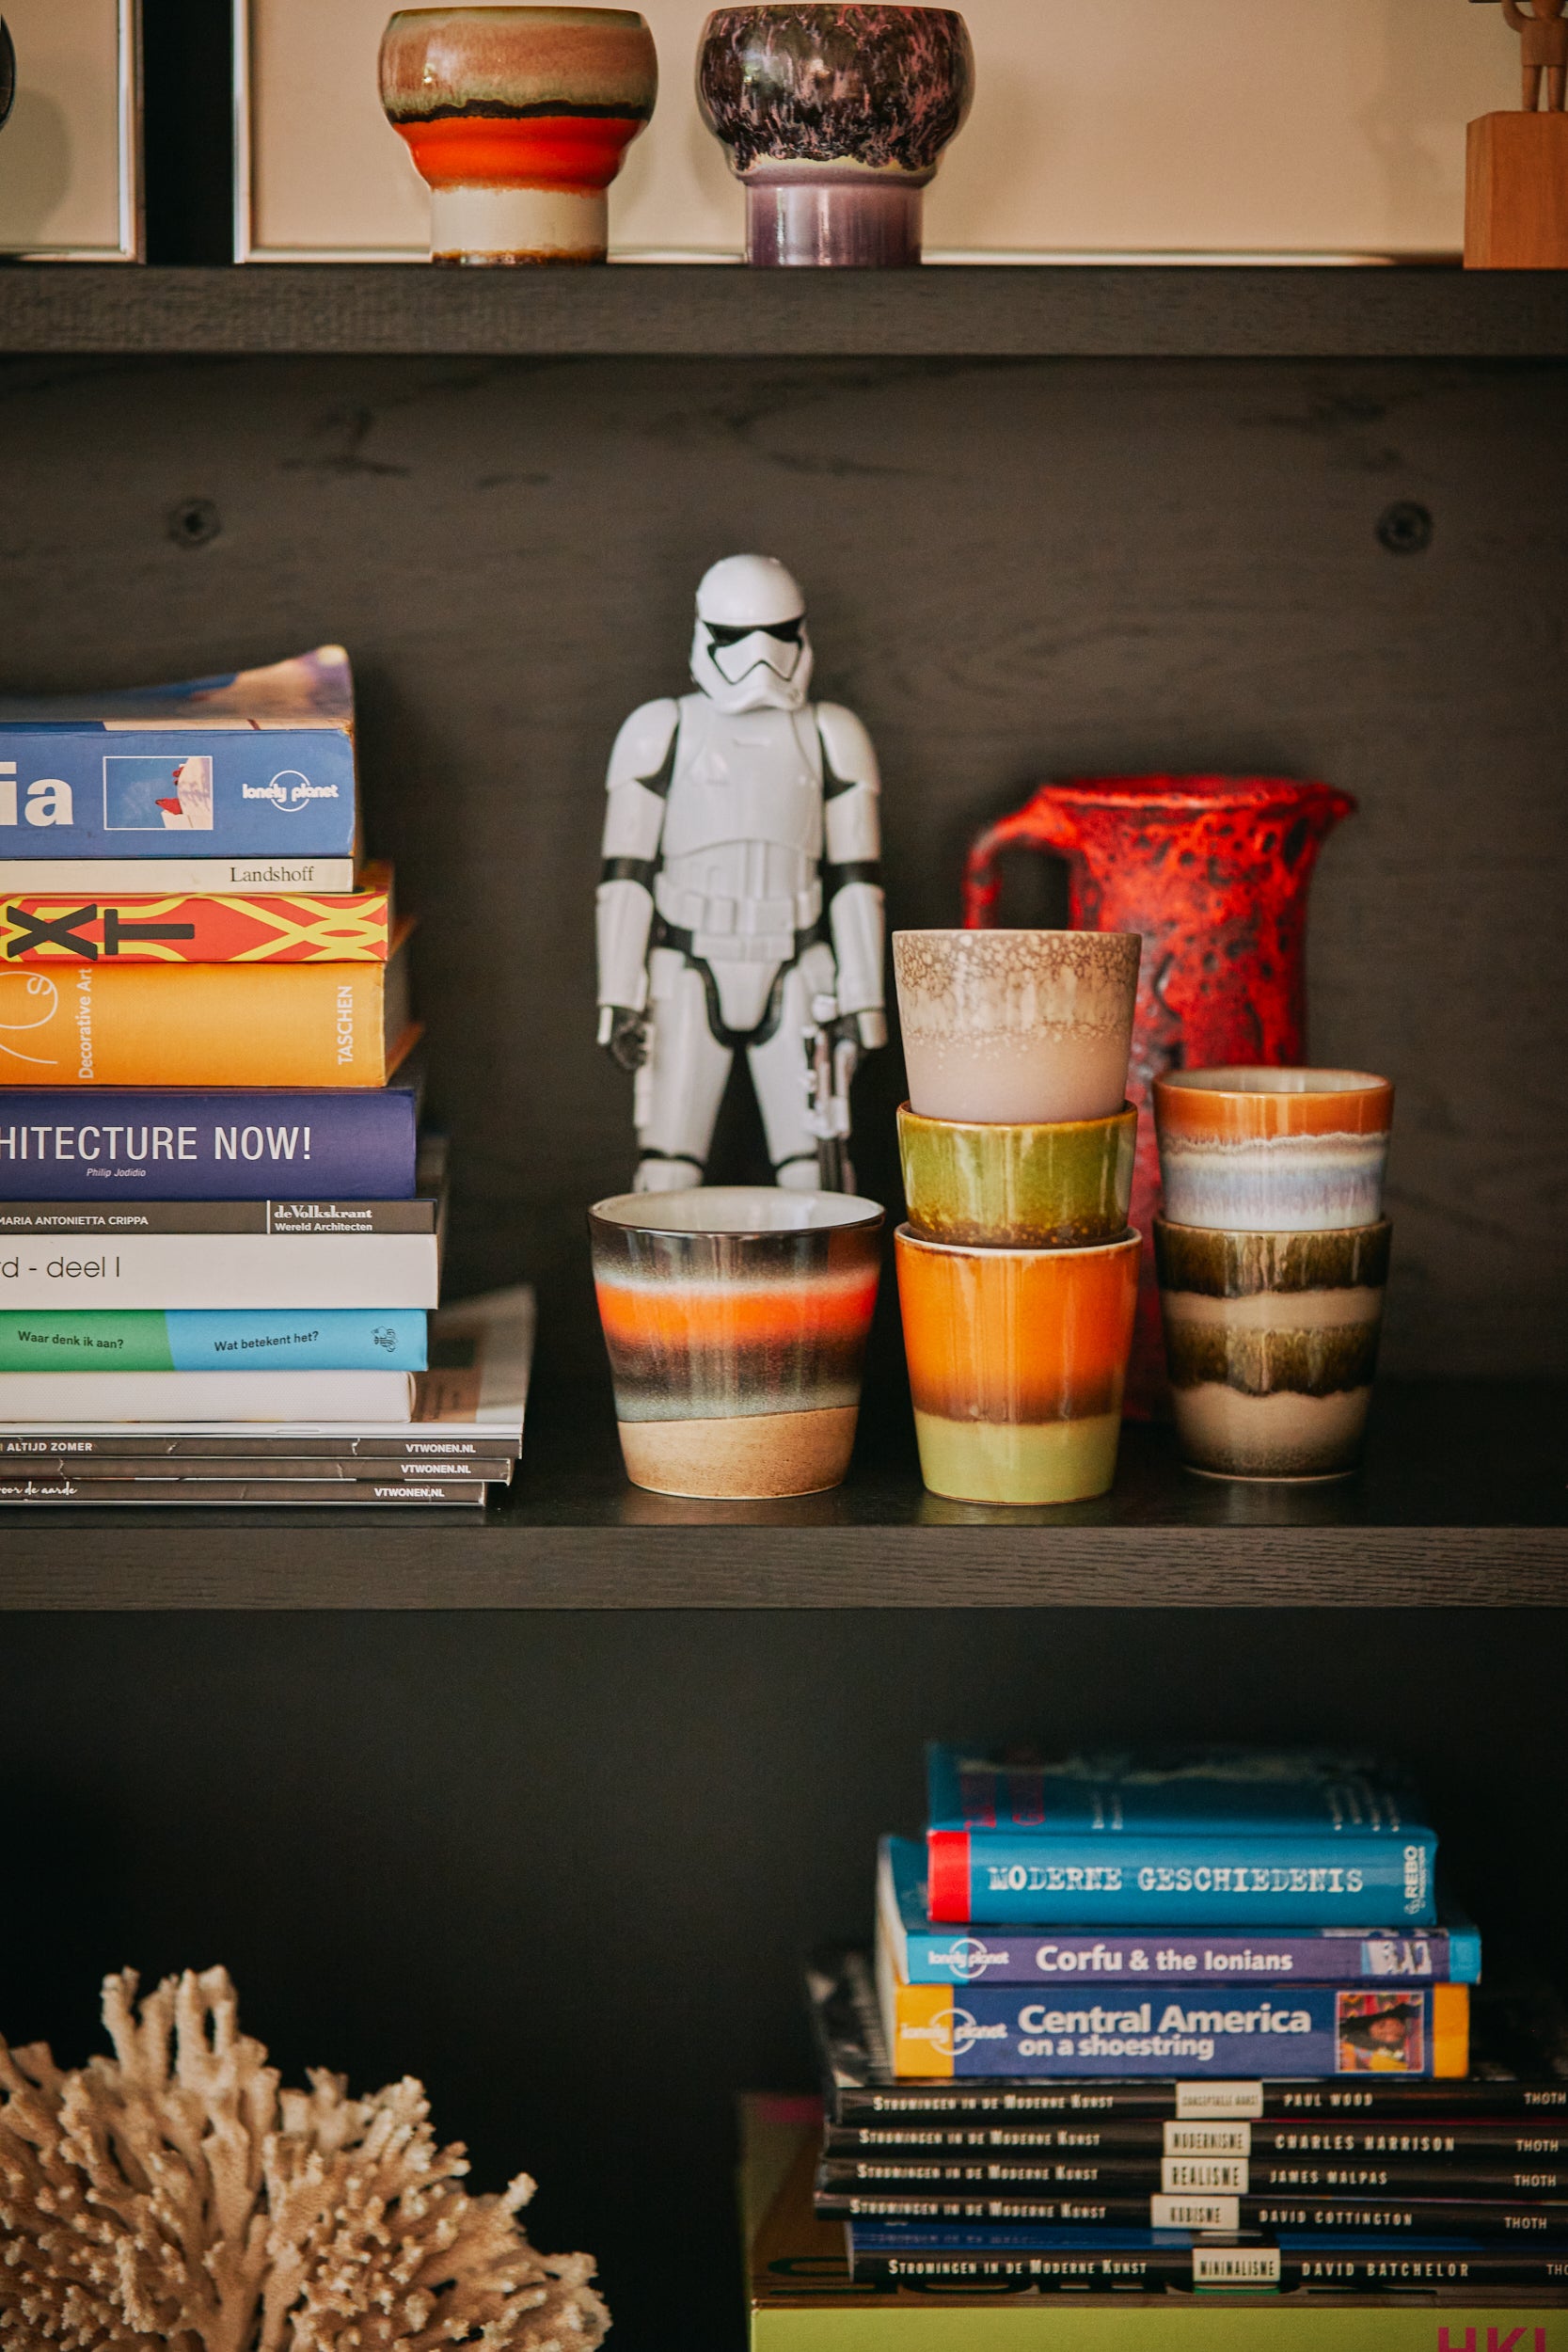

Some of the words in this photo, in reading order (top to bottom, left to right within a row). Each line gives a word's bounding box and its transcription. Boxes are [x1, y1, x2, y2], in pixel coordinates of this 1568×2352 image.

[242, 783, 287, 802] lonely
[291, 783, 340, 802] planet
[230, 866, 314, 882] Landshoff
[76, 967, 92, 992] Art
[336, 986, 354, 1065] TASCHEN
[76, 995, 94, 1079] Decorative
[214, 1126, 310, 1161] NOW!
[86, 1168, 112, 1179] Philip
[113, 1168, 147, 1177] Jodidio
[34, 1216, 106, 1226] ANTONIETTA
[107, 1216, 150, 1225] CRIPPA
[274, 1222, 312, 1232] Wereld
[313, 1222, 373, 1232] Architecten
[0, 1256, 19, 1279] d
[46, 1256, 105, 1279] deel
[17, 1330, 50, 1343] Waar
[52, 1333, 81, 1346] denk
[83, 1336, 94, 1347] ik
[96, 1339, 124, 1349] aan?
[214, 1341, 239, 1352] Wat
[241, 1335, 292, 1349] betekent
[293, 1330, 319, 1343] het?
[6, 1442, 48, 1452] ALTIJD
[50, 1442, 93, 1452] ZOMER
[404, 1443, 477, 1454] VTWONEN.NL
[400, 1464, 472, 1474] VTWONEN.NL
[0, 1486, 24, 1495] oor
[24, 1481, 40, 1496] de
[40, 1481, 78, 1496] aarde
[373, 1487, 446, 1499] VTWONEN.NL
[987, 1864, 1122, 1891] MODERNE
[1137, 1866, 1364, 1893] GESCHIEDENIS
[1403, 1845, 1418, 1899] REBO
[1036, 1944, 1123, 1972] Corfu
[1129, 1950, 1149, 1971] &
[1155, 1948, 1197, 1971] the
[1204, 1948, 1293, 1971] Ionians
[1018, 2003, 1151, 2034] Central
[1157, 2003, 1311, 2034] America
[1018, 2037, 1052, 2057] on
[1056, 2039, 1074, 2057] a
[1077, 2034, 1214, 2061] shoestring
[1283, 2093, 1322, 2106] PAUL
[1329, 2093, 1373, 2106] WOOD
[1524, 2092, 1566, 2105] THOTH
[1173, 2133, 1243, 2150] MODERNISME
[1275, 2134, 1355, 2151] CHARLES
[1363, 2136, 1455, 2152] HARRISON
[1515, 2138, 1559, 2153] THOTH
[1172, 2167, 1241, 2186] REALISME
[1270, 2169, 1319, 2184] JAMES
[1327, 2170, 1388, 2185] MALPAS
[1513, 2174, 1557, 2187] THOTH
[1259, 2209, 1307, 2224] DAVID
[1314, 2210, 1412, 2226] COTTINGTON
[1504, 2217, 1547, 2230] THOTH
[1006, 2262, 1022, 2274] DE
[1199, 2261, 1275, 2277] MINIMALISME
[1302, 2262, 1355, 2277] DAVID
[1367, 2263, 1469, 2277] BATCHELOR
